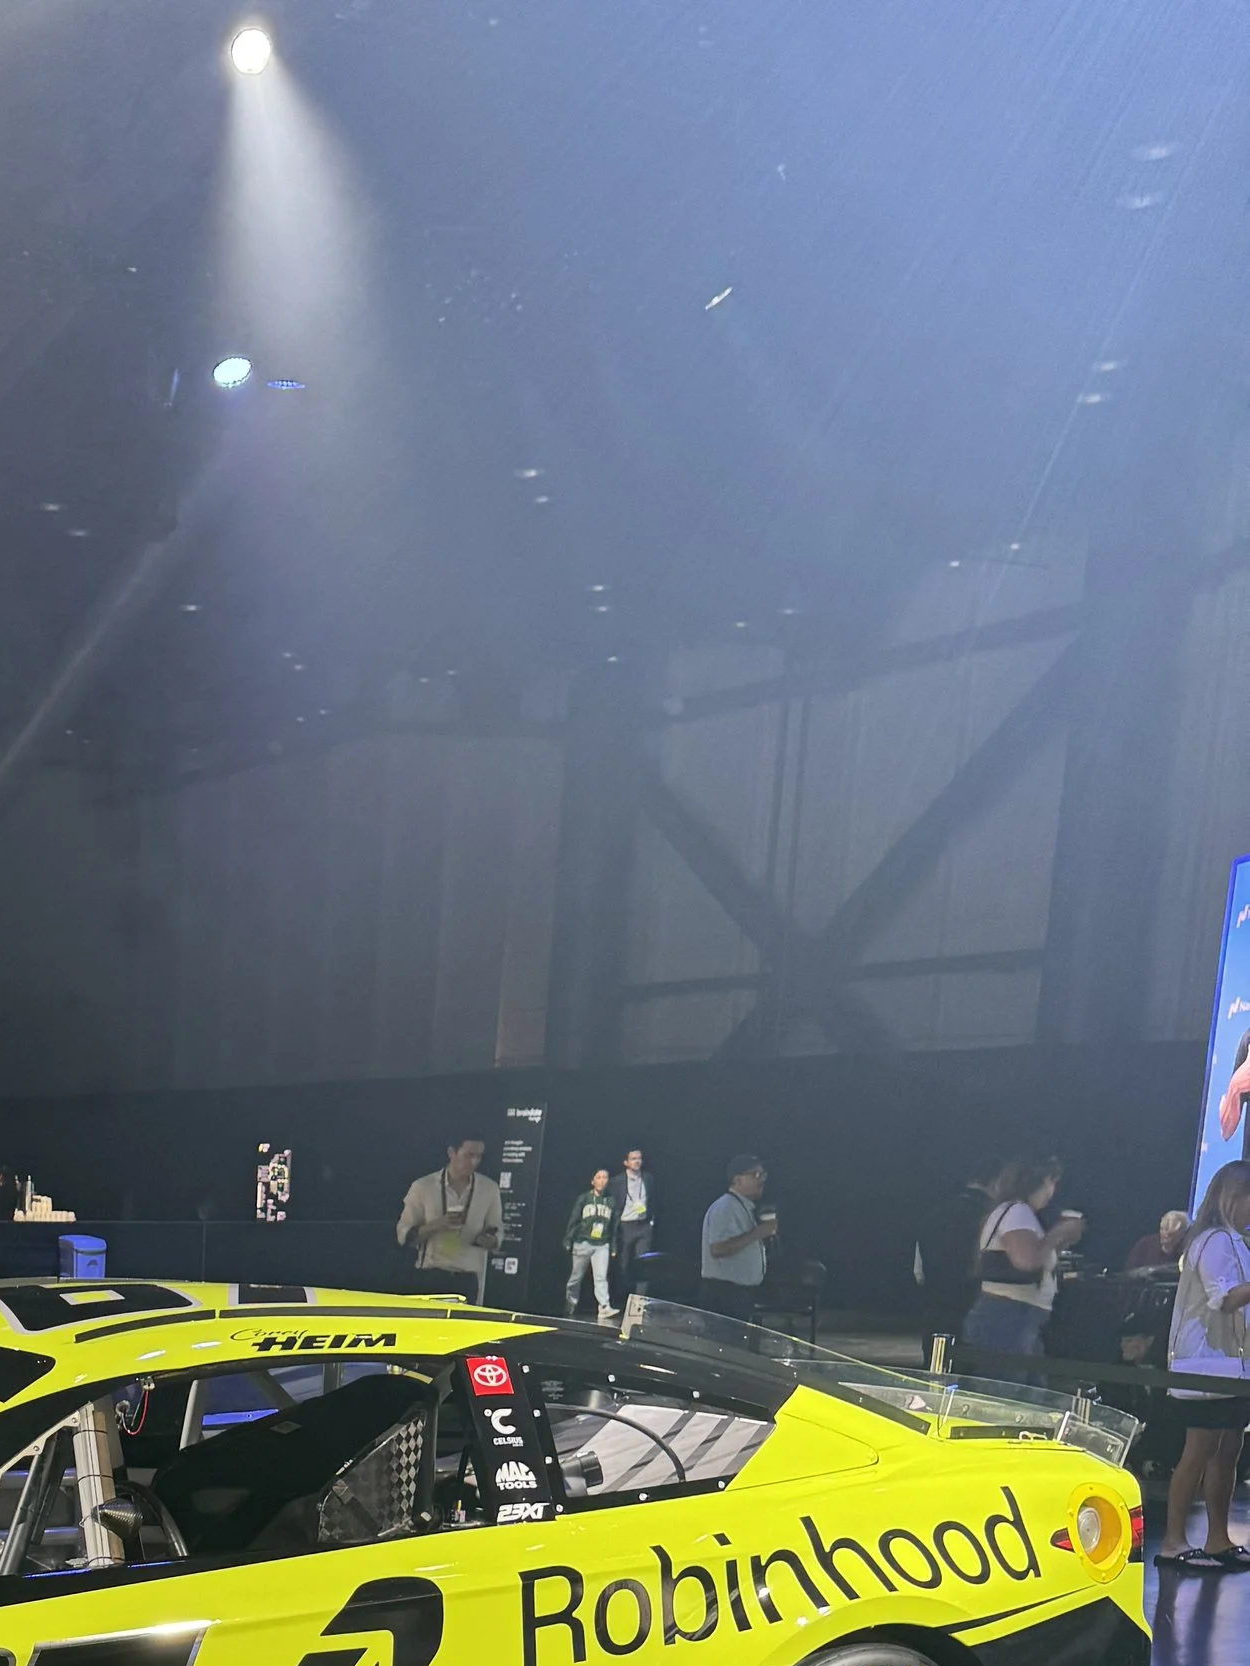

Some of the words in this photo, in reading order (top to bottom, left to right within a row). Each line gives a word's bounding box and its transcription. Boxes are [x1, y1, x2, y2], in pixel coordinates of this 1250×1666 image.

[251, 1333, 397, 1352] HEIM
[493, 1437, 524, 1446] CELSIUS
[495, 1461, 536, 1482] MAC
[497, 1481, 538, 1491] TOOLS
